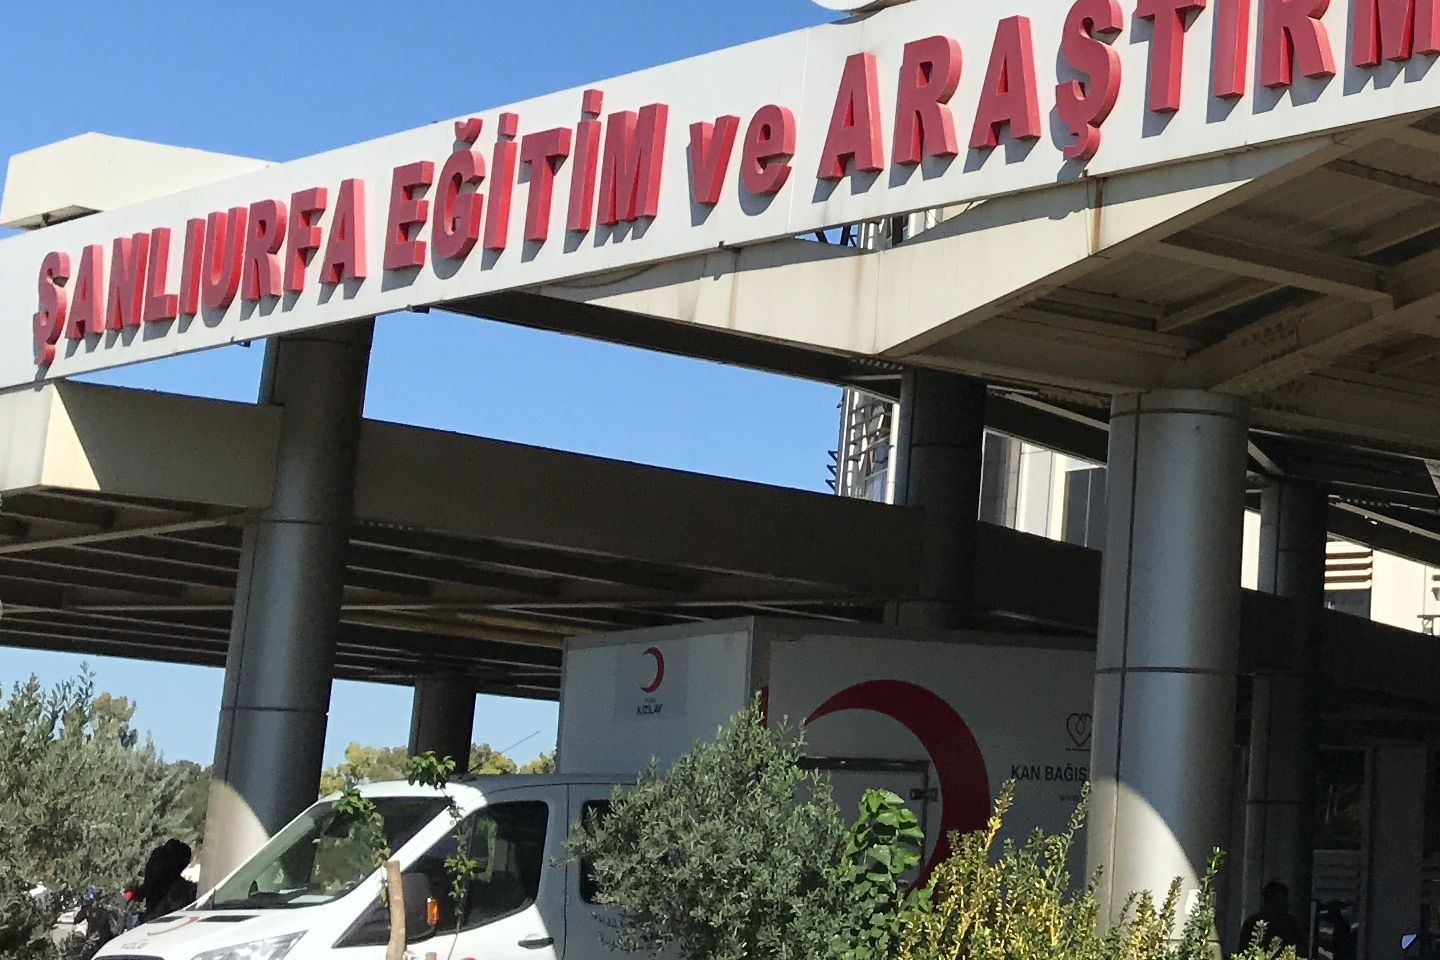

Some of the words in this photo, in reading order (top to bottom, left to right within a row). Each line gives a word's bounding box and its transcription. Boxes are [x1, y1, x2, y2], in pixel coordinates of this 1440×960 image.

[34, 177, 367, 366] ŞANLIURFA
[383, 88, 669, 271] EĞİTİM
[689, 103, 797, 206] ve
[1011, 765, 1041, 781] KAN
